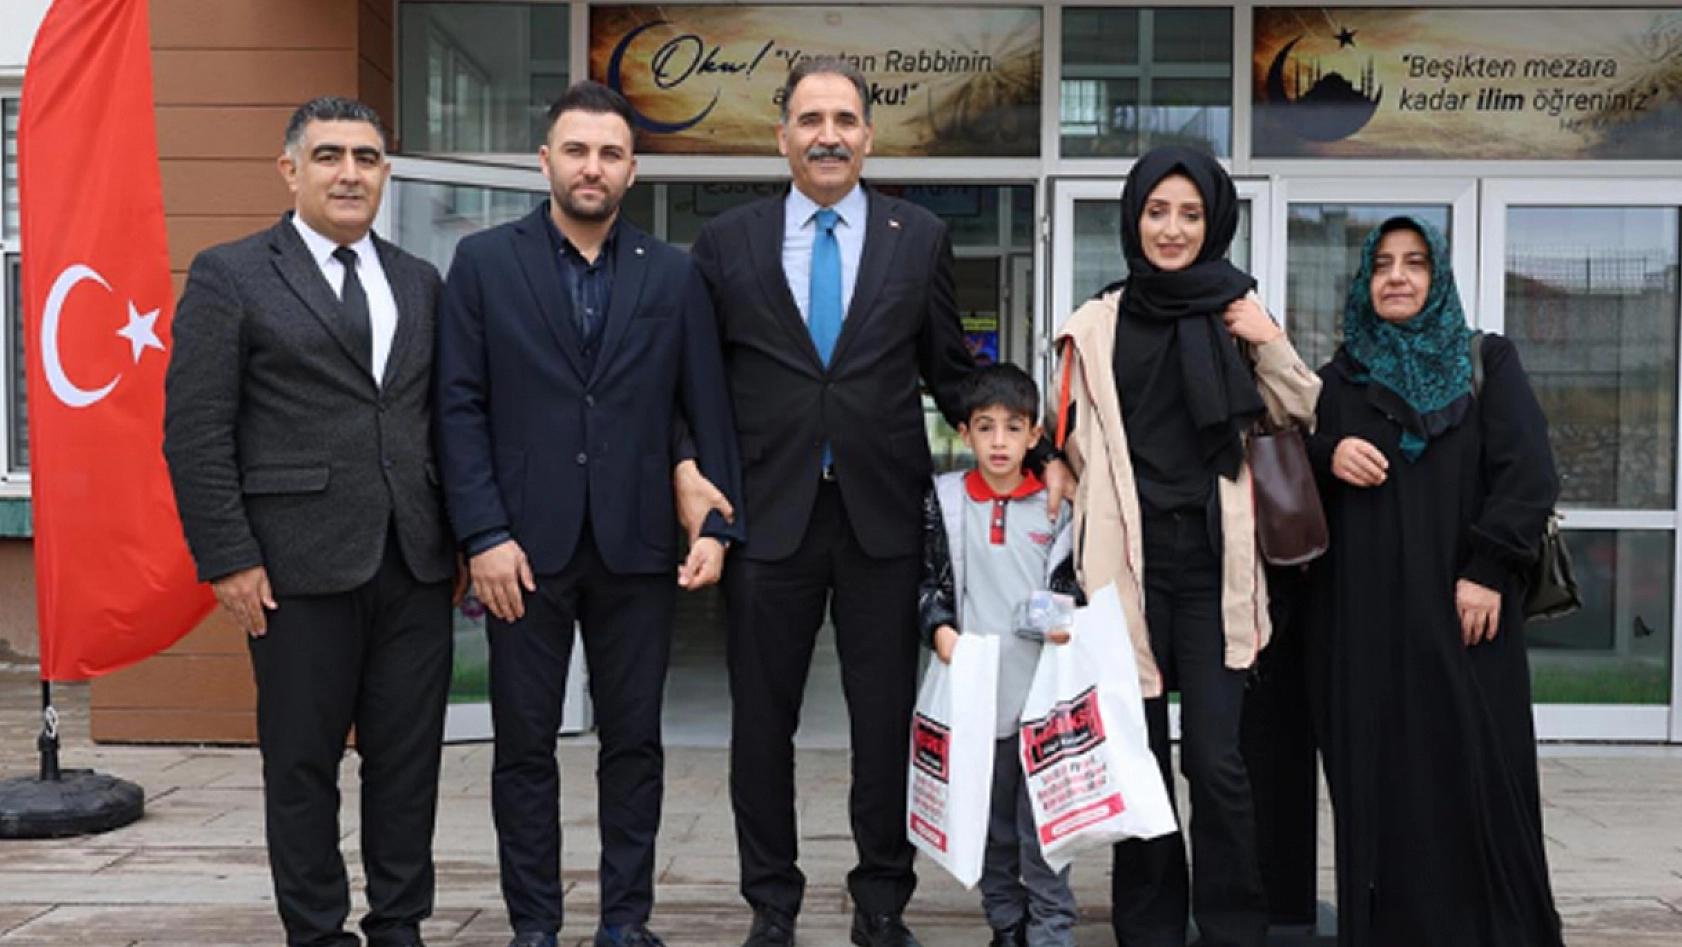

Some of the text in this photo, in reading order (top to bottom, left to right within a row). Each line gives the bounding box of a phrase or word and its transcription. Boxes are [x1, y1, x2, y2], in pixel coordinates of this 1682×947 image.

[652, 34, 776, 90] Oku!
[883, 48, 993, 73] Rabbinin
[1523, 58, 1618, 78] mezara
[866, 82, 919, 103] ku!"
[1398, 87, 1471, 111] kadar
[1475, 87, 1525, 111] ilim
